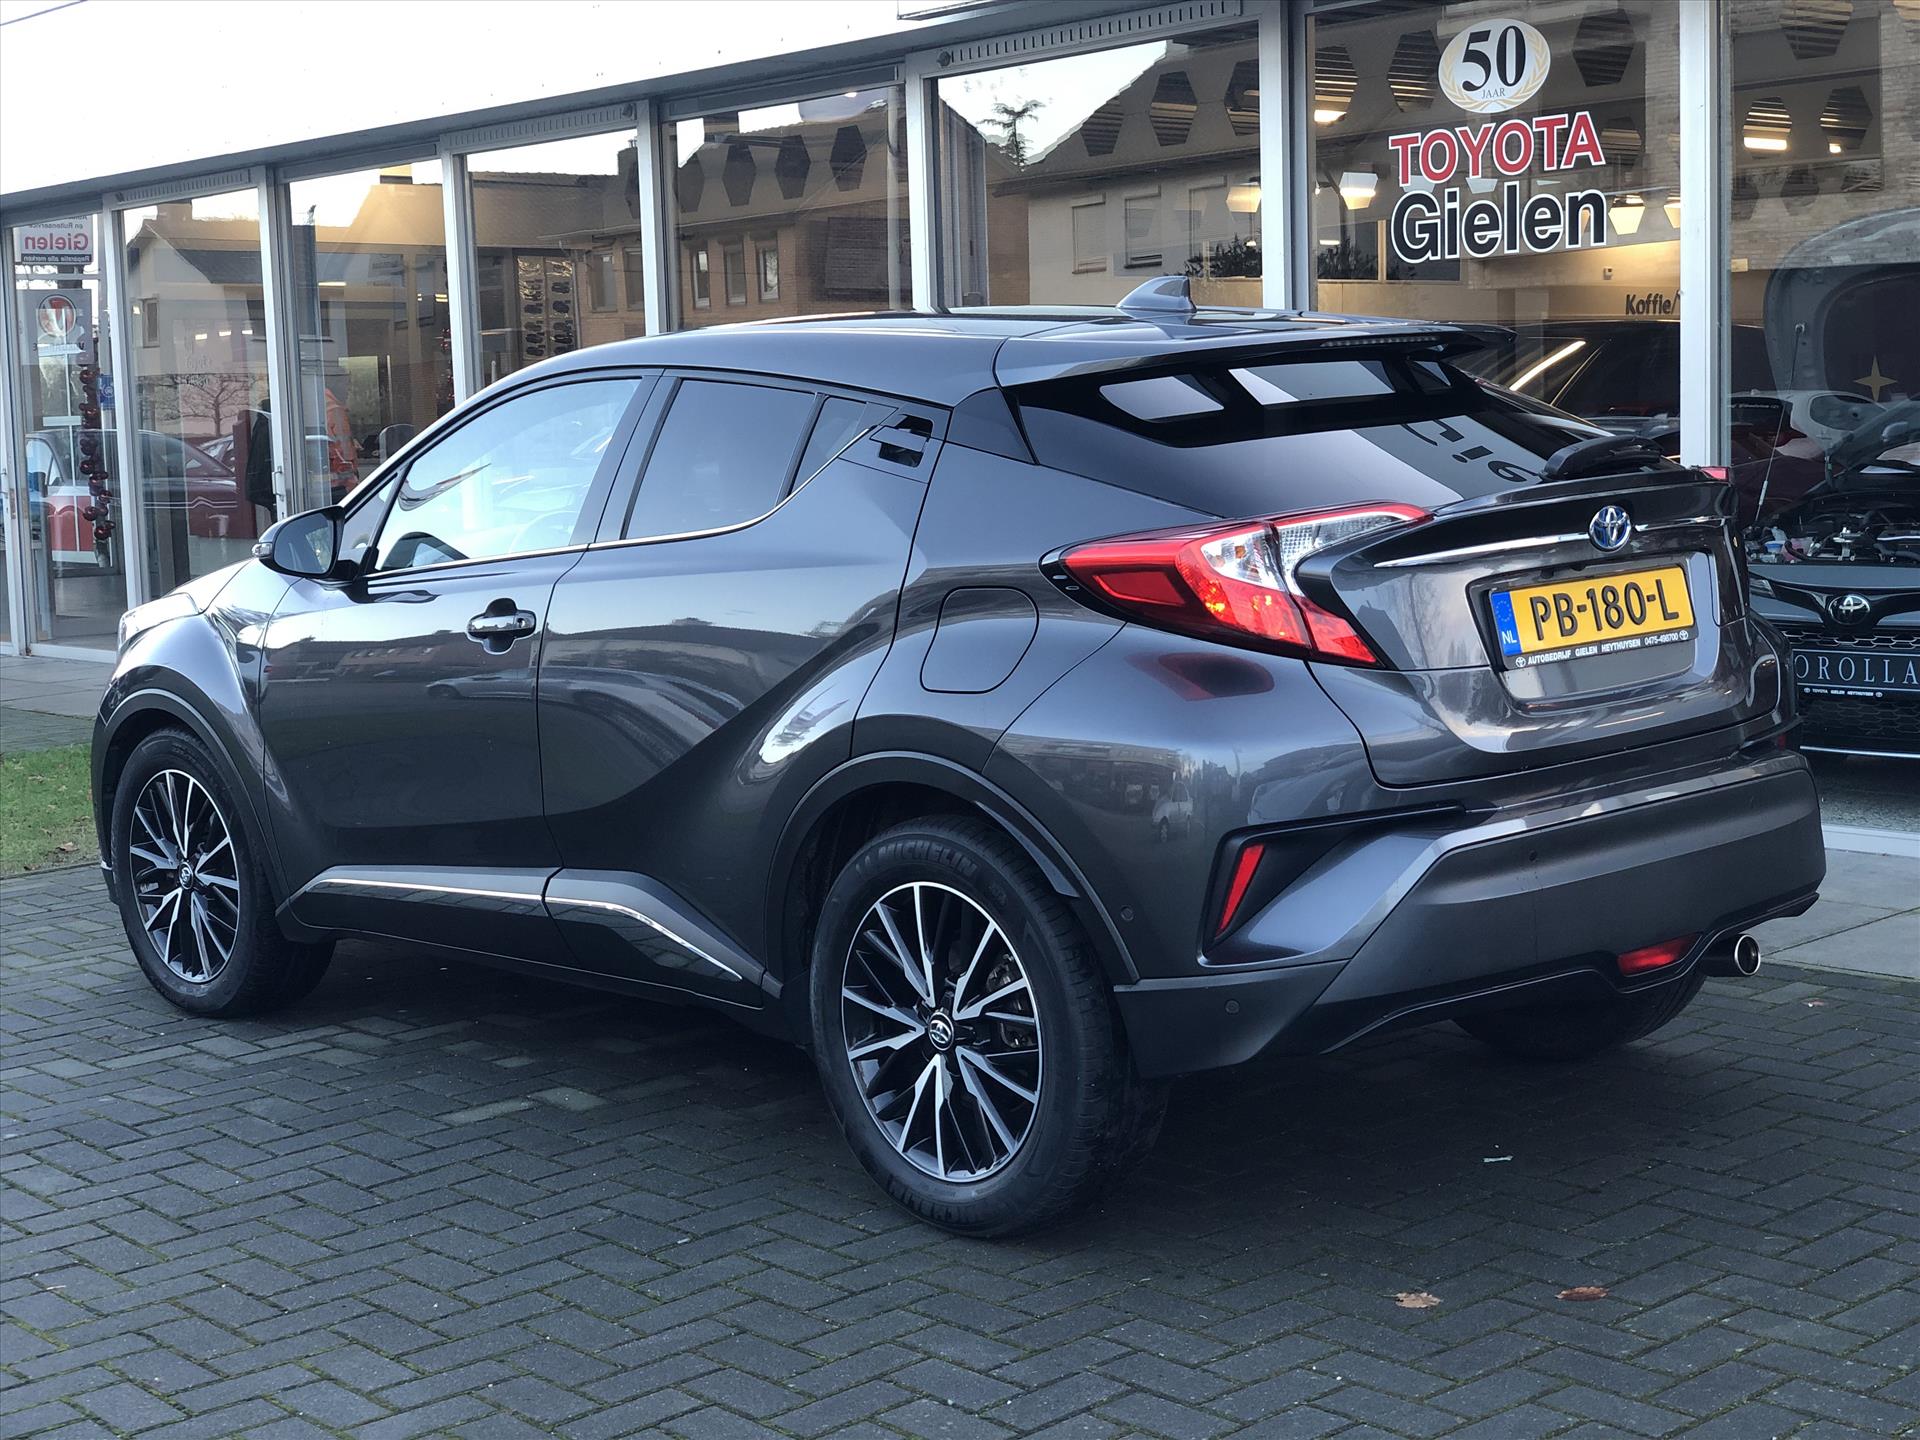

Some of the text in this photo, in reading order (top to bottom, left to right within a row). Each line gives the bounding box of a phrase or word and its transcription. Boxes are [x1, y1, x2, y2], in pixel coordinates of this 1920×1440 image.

[1461, 24, 1527, 92] 50
[1481, 87, 1506, 99] JAAR
[1388, 111, 1606, 188] TOYOTA
[1390, 181, 1607, 264] Gielen
[1529, 578, 1680, 642] PB-180-L
[1501, 629, 1518, 645] NL
[1527, 650, 1572, 665] AUTOBEDRIJF
[1575, 647, 1598, 658] GIELEN
[1601, 637, 1641, 654] HEYTHUYSEN
[1794, 654, 1919, 685] OROLLA
